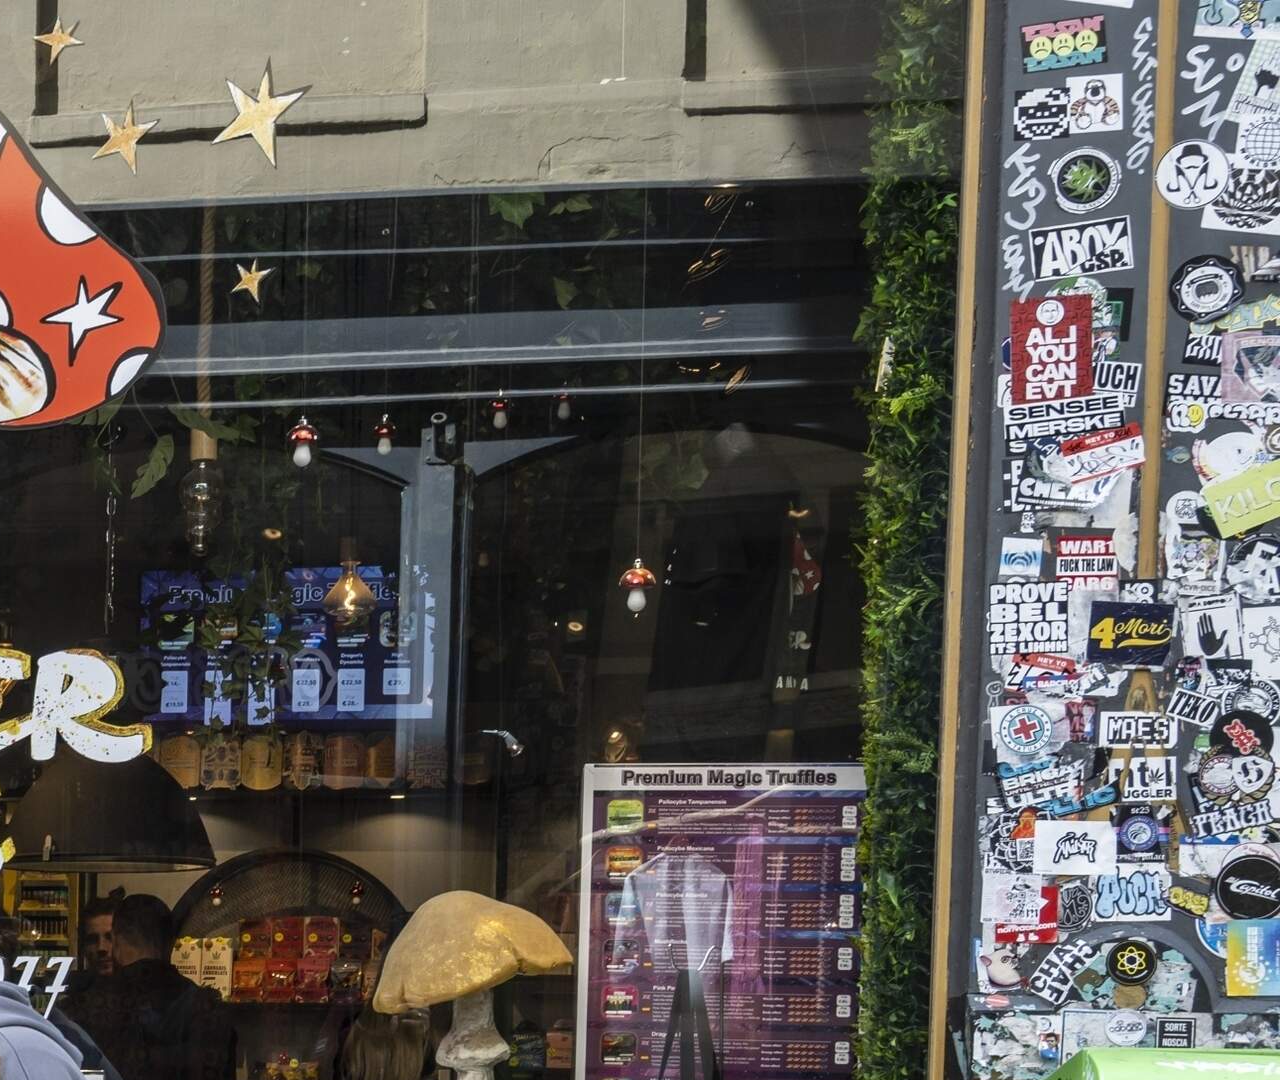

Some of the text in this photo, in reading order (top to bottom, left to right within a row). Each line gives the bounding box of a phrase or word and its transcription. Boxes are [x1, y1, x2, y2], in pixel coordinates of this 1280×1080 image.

[1025, 346, 1077, 363] YOU
[1025, 362, 1077, 382] CAN
[1094, 364, 1139, 392] UCH
[1008, 394, 1121, 421] SENSEE
[1009, 412, 1123, 442] MERSKE
[1059, 557, 1115, 574] FUCK THE LAW
[989, 582, 1068, 605] PROVE
[990, 603, 1068, 623] BEL
[989, 622, 1068, 643] ZEXOR
[1170, 690, 1218, 725] TEKO
[621, 769, 838, 789] Premium Magic Truffles
